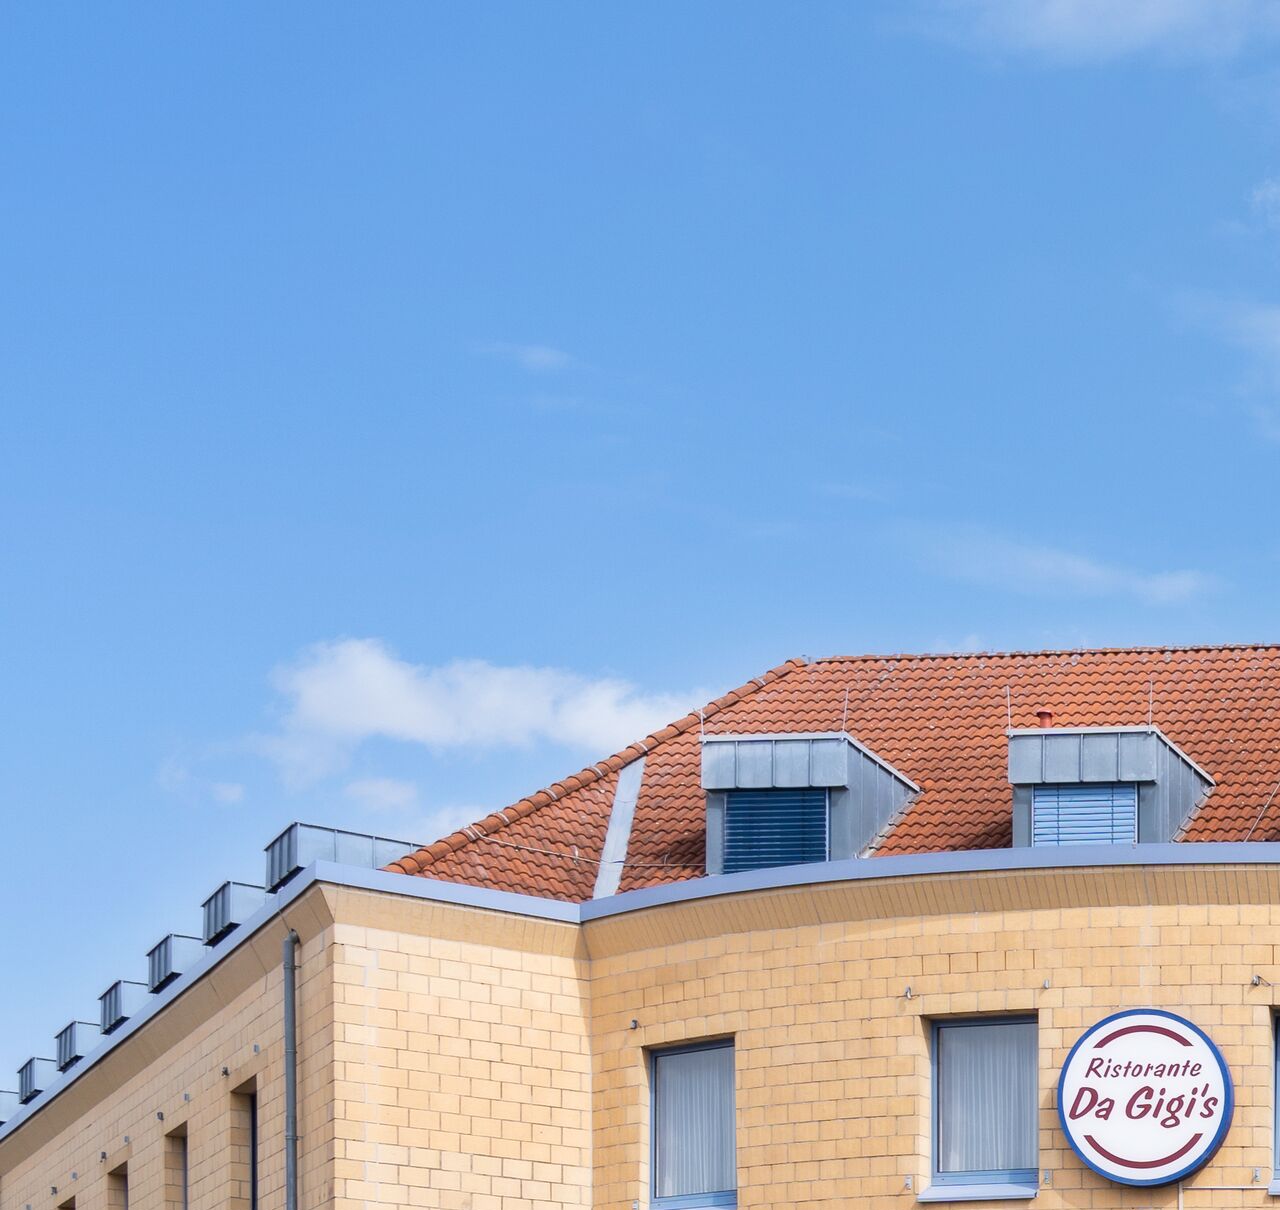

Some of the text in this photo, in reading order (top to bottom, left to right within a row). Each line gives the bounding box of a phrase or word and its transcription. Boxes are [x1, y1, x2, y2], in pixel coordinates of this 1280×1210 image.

[1085, 1057, 1203, 1079] Ristorante
[1068, 1083, 1219, 1128] Da Gigi's
